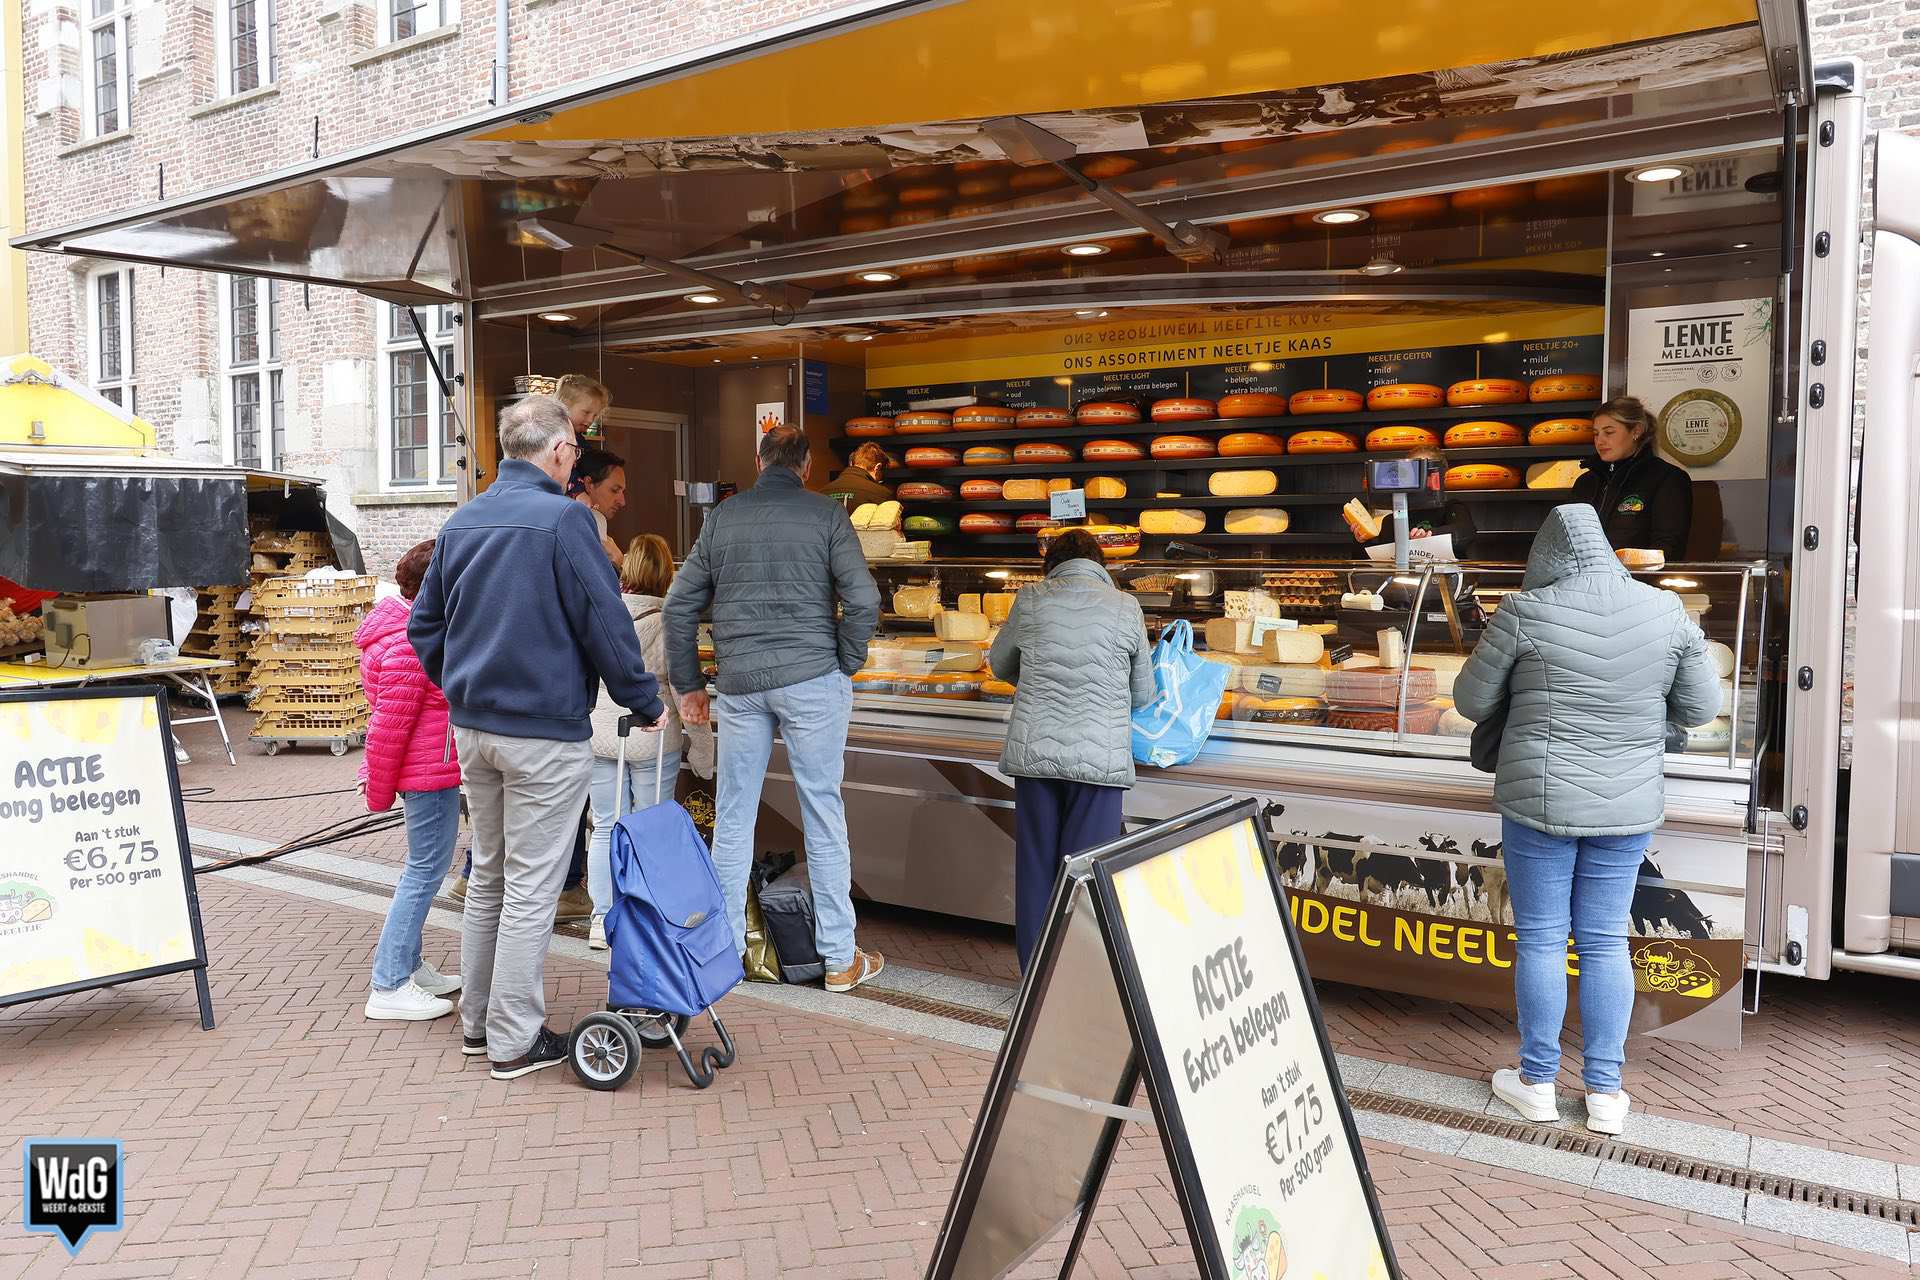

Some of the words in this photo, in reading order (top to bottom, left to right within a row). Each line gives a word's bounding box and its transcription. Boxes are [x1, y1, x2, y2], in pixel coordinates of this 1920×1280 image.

[1664, 321, 1733, 348] LENTE
[1064, 356, 1093, 369] ONS
[1098, 347, 1207, 367] ASSORTIMENT
[1213, 341, 1281, 358] NEELTJE
[1288, 336, 1333, 352] KAAS
[1523, 342, 1560, 351] NEELTJE
[1562, 341, 1580, 349] 20+
[1661, 345, 1735, 359] MELANGE
[1369, 354, 1401, 362] NEELTJE
[1403, 352, 1432, 360] GEITEN
[1529, 355, 1549, 363] mild
[1225, 365, 1256, 373] NEELT
[1374, 366, 1392, 374] mild
[1529, 367, 1563, 376] kruiden
[1006, 380, 1031, 388] NEELTJE
[1104, 373, 1130, 382] NEELTJE
[1131, 372, 1151, 380] LIGHT
[1374, 378, 1398, 387] pikant
[1151, 382, 1178, 390] belegen
[1250, 386, 1278, 394] belegen
[1010, 400, 1037, 408] overjarig
[1685, 419, 1709, 428] LENTE
[14, 754, 105, 790] ACTIE
[0, 797, 43, 824] ong
[50, 786, 141, 816] belegen
[74, 830, 99, 844] Aan
[114, 824, 141, 839] stuk
[63, 839, 159, 873] €6,75
[0, 871, 39, 881] SHANDEL
[69, 876, 93, 890] Per
[96, 872, 125, 887] 500
[128, 867, 162, 884] gram
[0, 923, 41, 937] EELTJE
[1394, 916, 1580, 977] NEELE
[1192, 936, 1254, 1021] ACTIE
[1183, 1037, 1234, 1094] Extra
[1229, 990, 1291, 1057] belegen
[1261, 1083, 1278, 1109] Aan
[1285, 1059, 1303, 1089] stuk
[1265, 1083, 1323, 1165] €7,75
[1280, 1174, 1295, 1202] Per
[1294, 1151, 1314, 1185] 500
[1313, 1133, 1334, 1174] gram
[1225, 1184, 1262, 1226] KAASHANDEL
